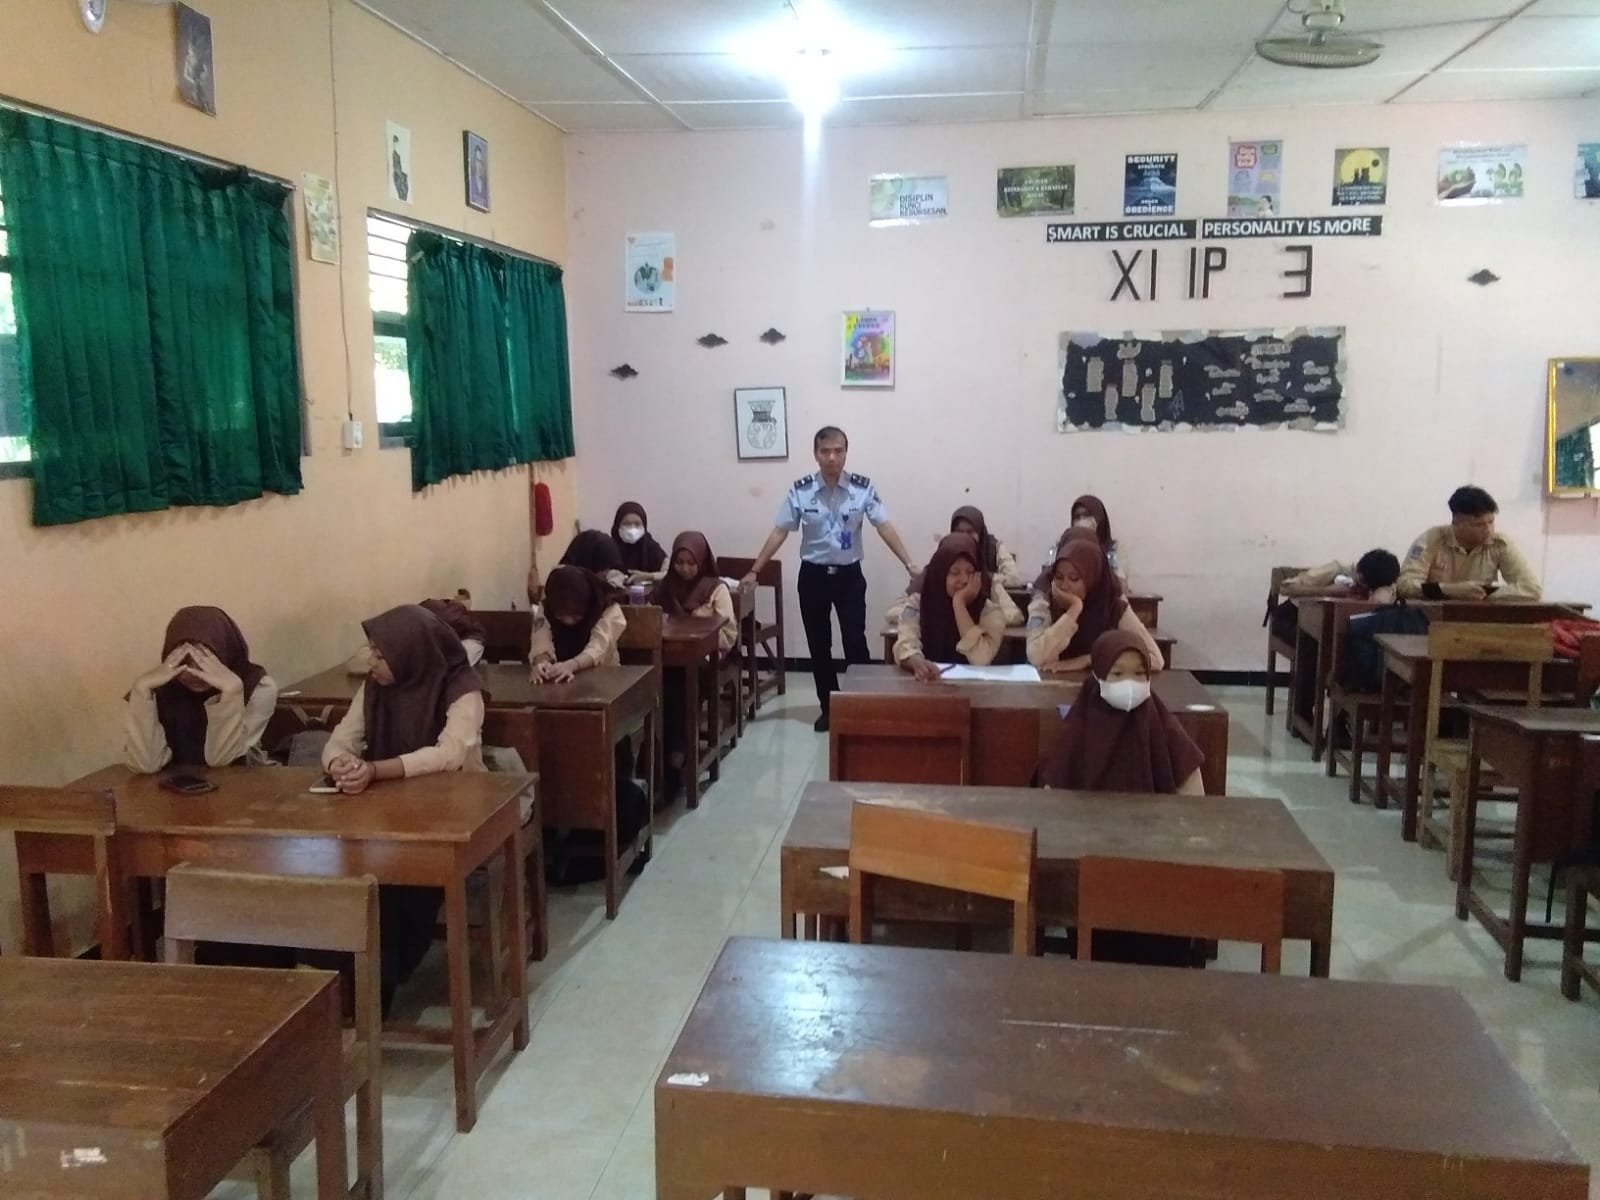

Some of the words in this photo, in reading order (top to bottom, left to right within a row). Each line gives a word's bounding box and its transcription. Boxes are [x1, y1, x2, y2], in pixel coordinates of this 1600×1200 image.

[1128, 155, 1175, 164] SECURITY
[900, 194, 934, 202] DISIPLIN
[1125, 205, 1174, 214] OBEDIENCE
[1048, 225, 1100, 241] SMART
[1105, 225, 1118, 239] IS
[1123, 223, 1187, 238] CRUCIAL
[1205, 220, 1304, 236] PERSONALITY
[1308, 220, 1321, 234] IS
[1325, 217, 1371, 233] MORE
[1110, 248, 1157, 301] XI
